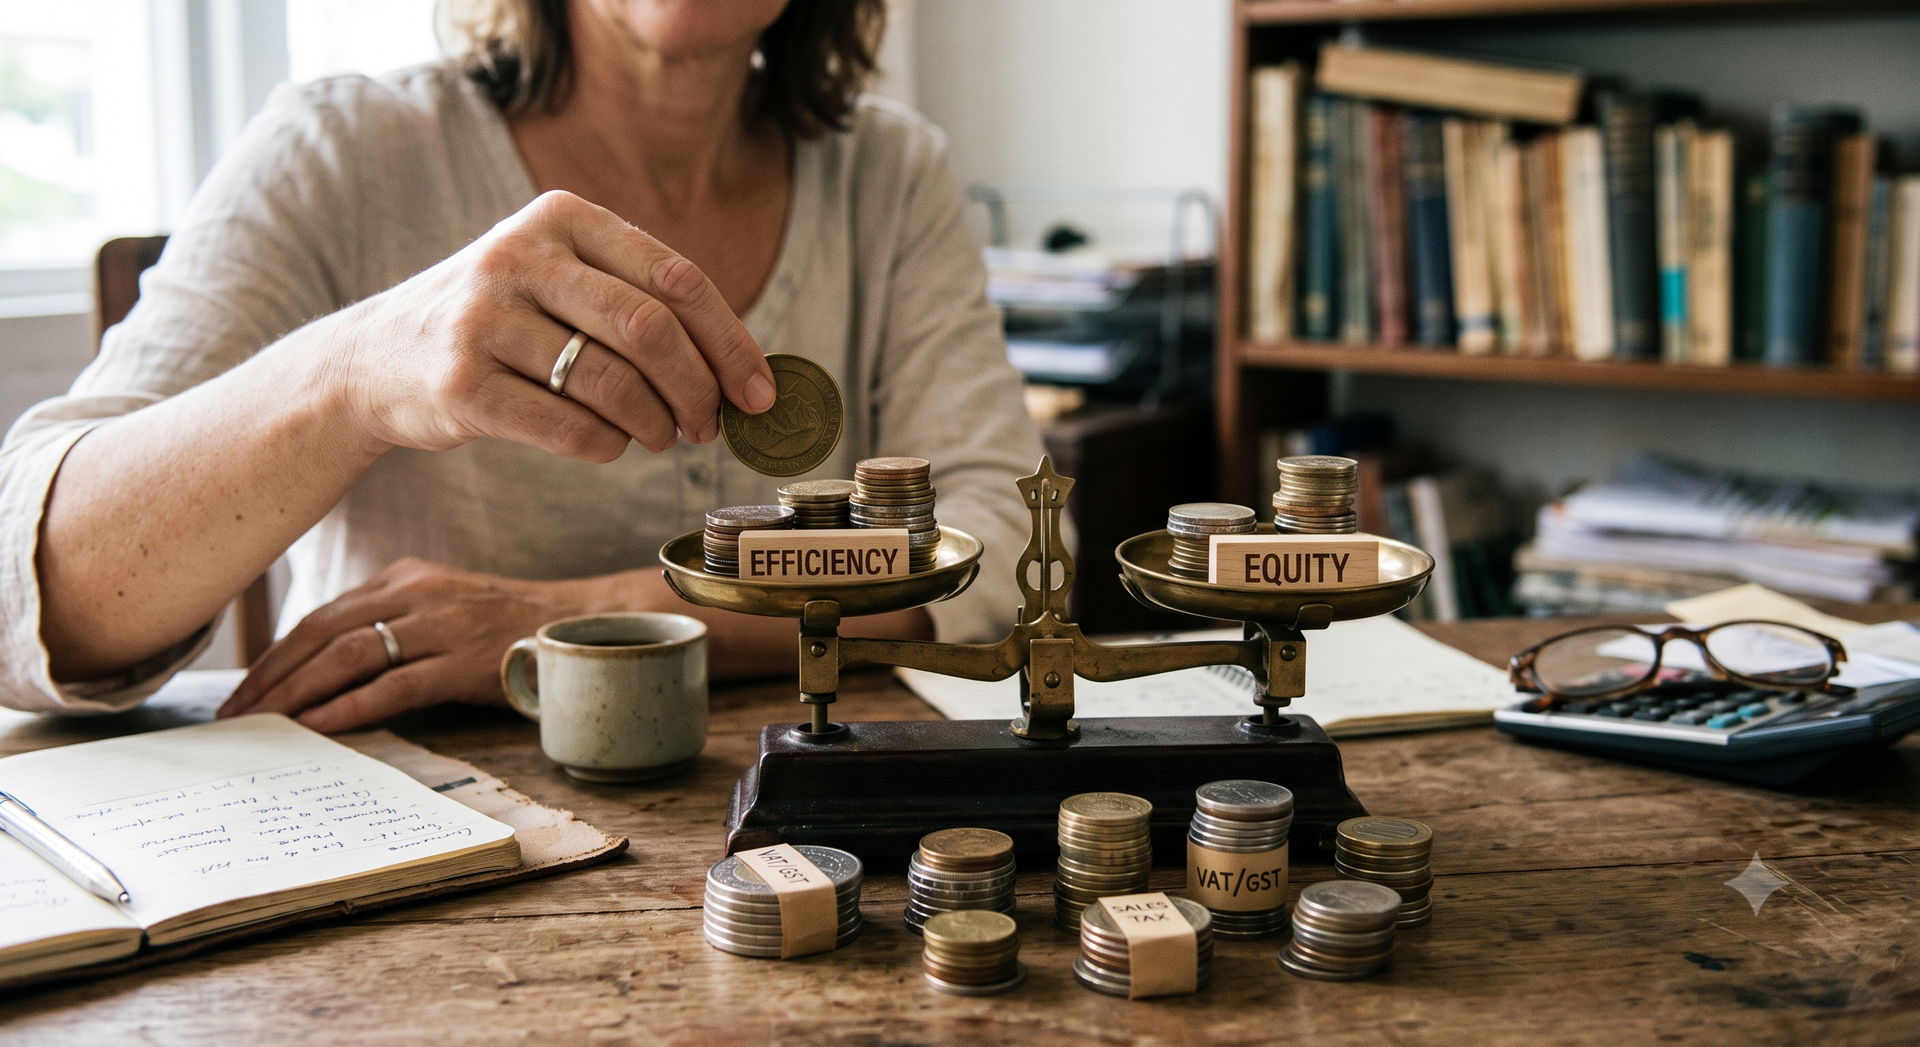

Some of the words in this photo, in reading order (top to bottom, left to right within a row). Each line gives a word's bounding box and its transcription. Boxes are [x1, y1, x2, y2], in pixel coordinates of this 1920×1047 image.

[750, 548, 899, 576] EFFICIENCY
[1244, 553, 1350, 586] EQUITY
[757, 848, 810, 884] VAT/GST
[1196, 866, 1282, 897] VAT/GST
[1111, 901, 1168, 913] SALES
[1126, 913, 1169, 923] TAX
